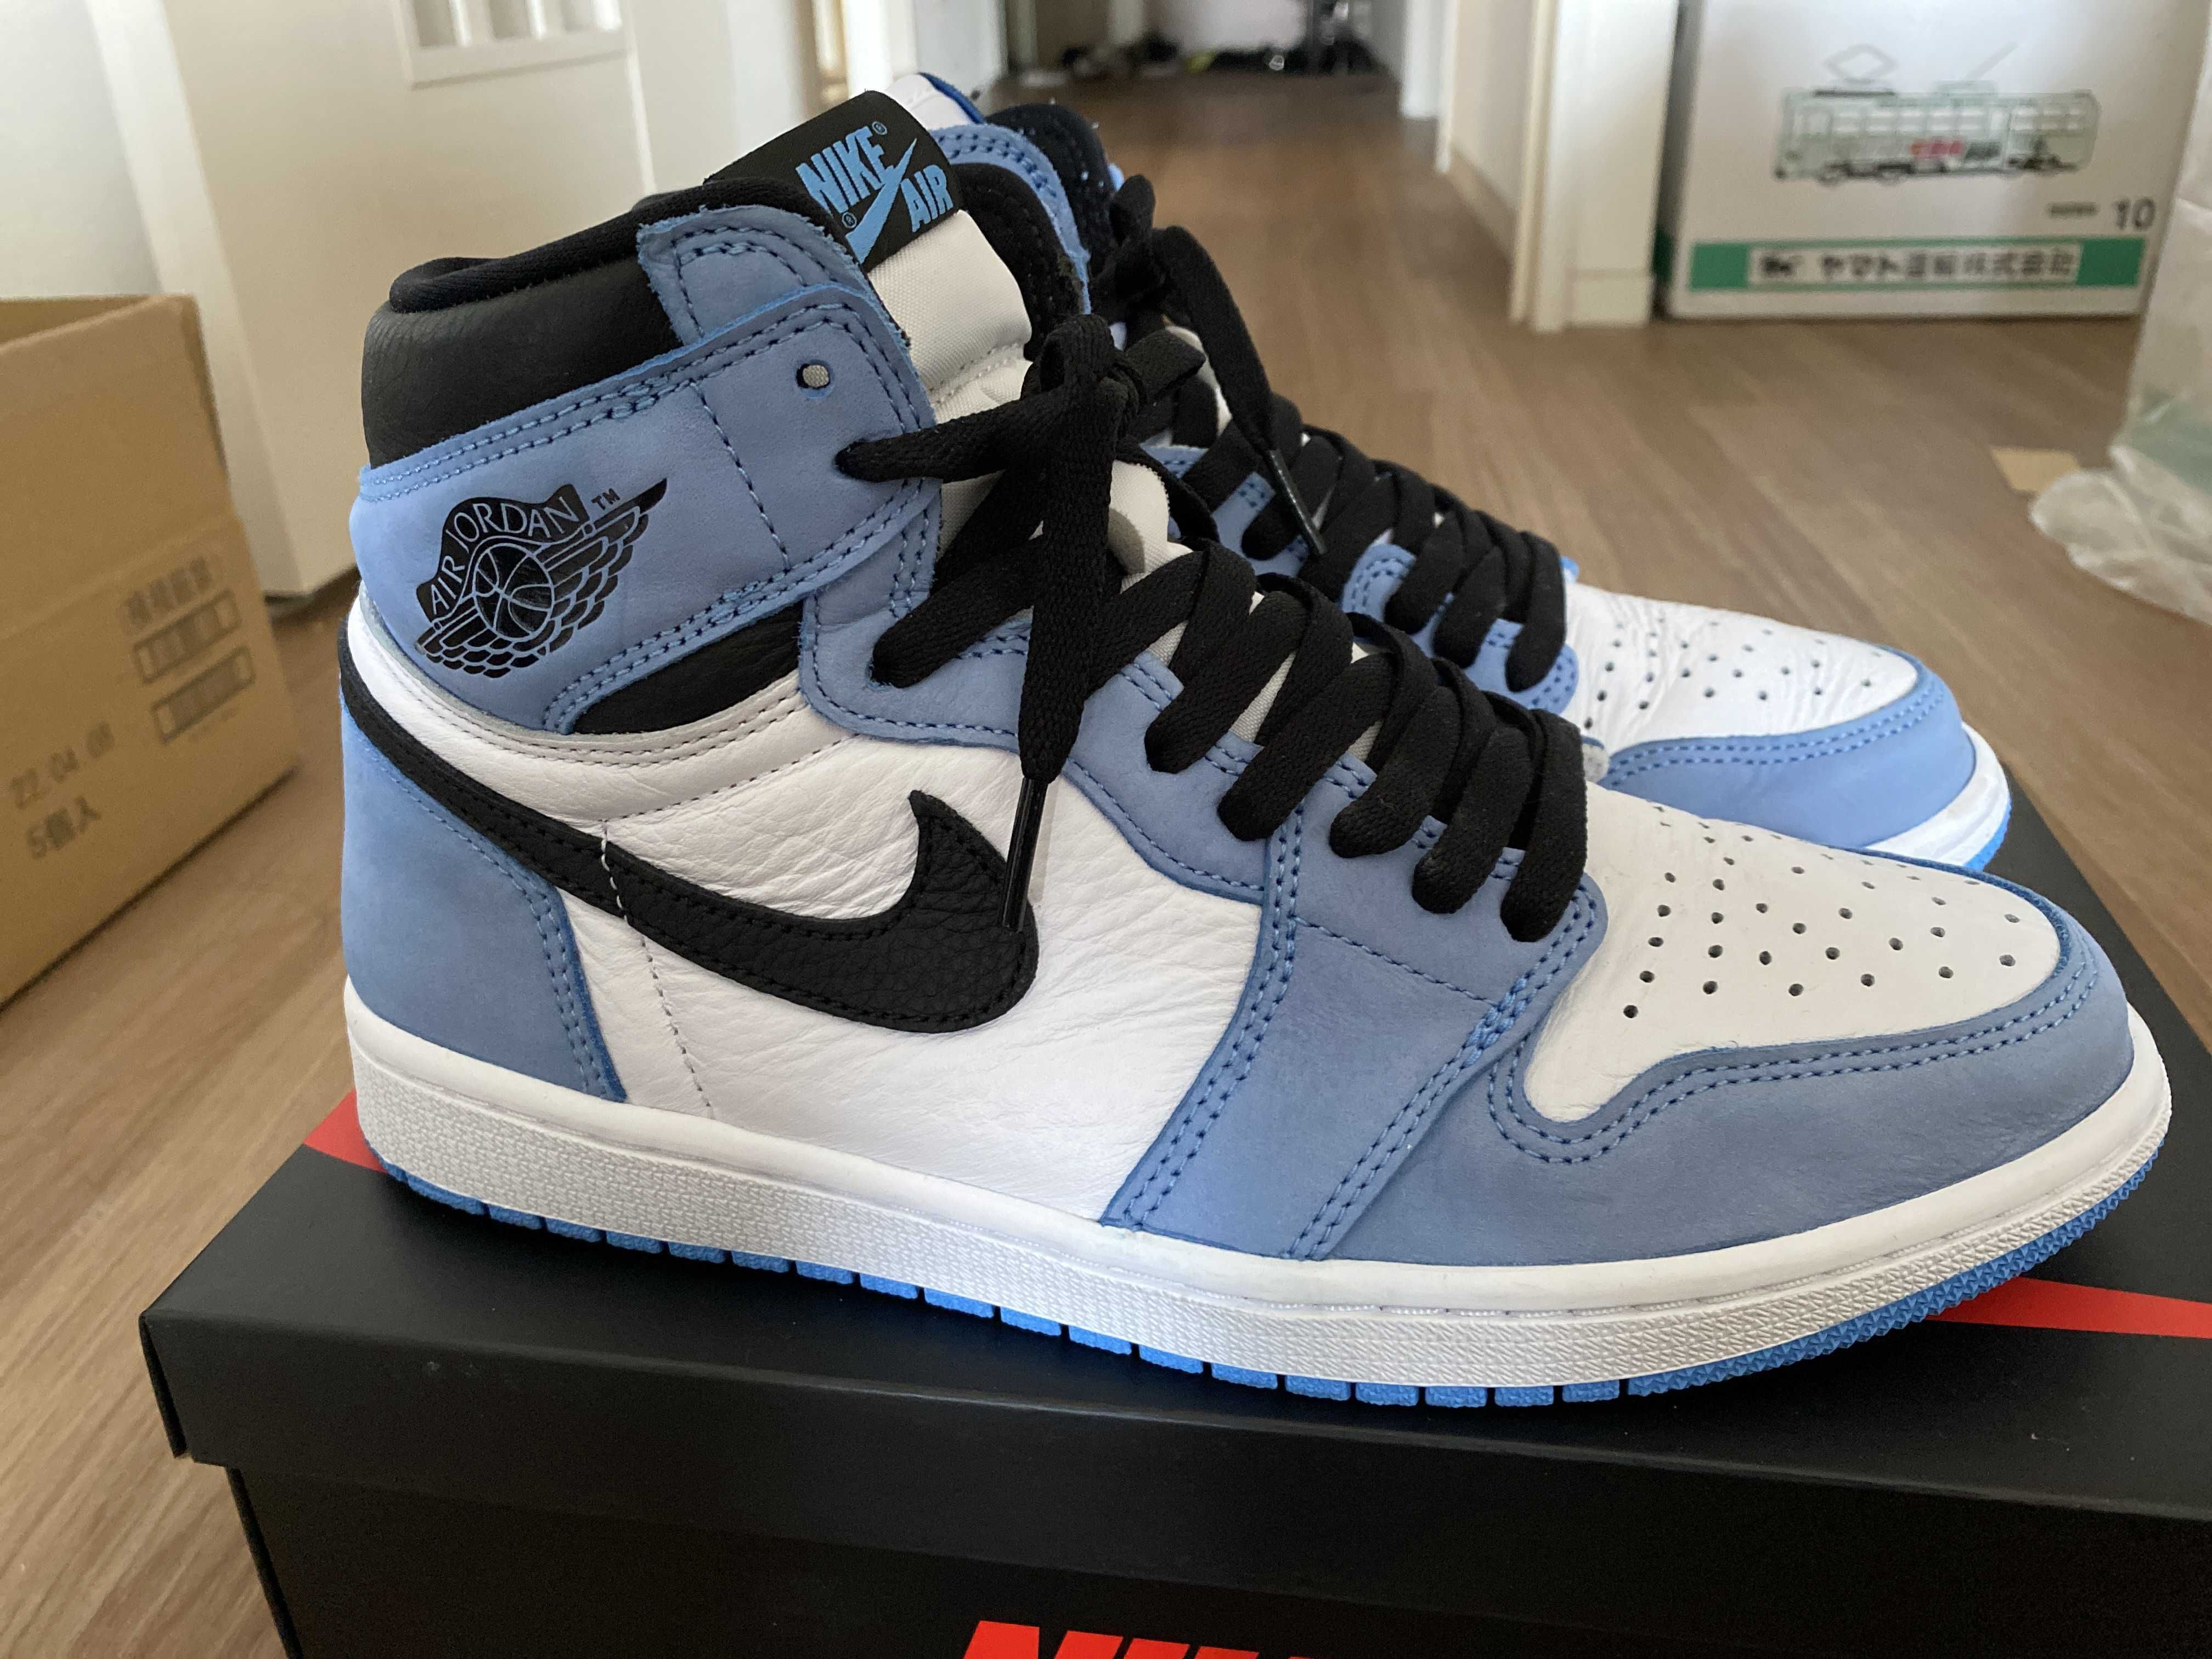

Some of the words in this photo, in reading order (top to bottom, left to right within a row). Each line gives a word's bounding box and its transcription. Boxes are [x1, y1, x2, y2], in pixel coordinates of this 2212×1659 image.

[795, 126, 894, 216] NIKE
[900, 165, 953, 233] AIR
[2114, 196, 2155, 231] 10
[445, 496, 580, 553] JORDAN
[591, 487, 621, 510] TM
[429, 554, 465, 615] AIR
